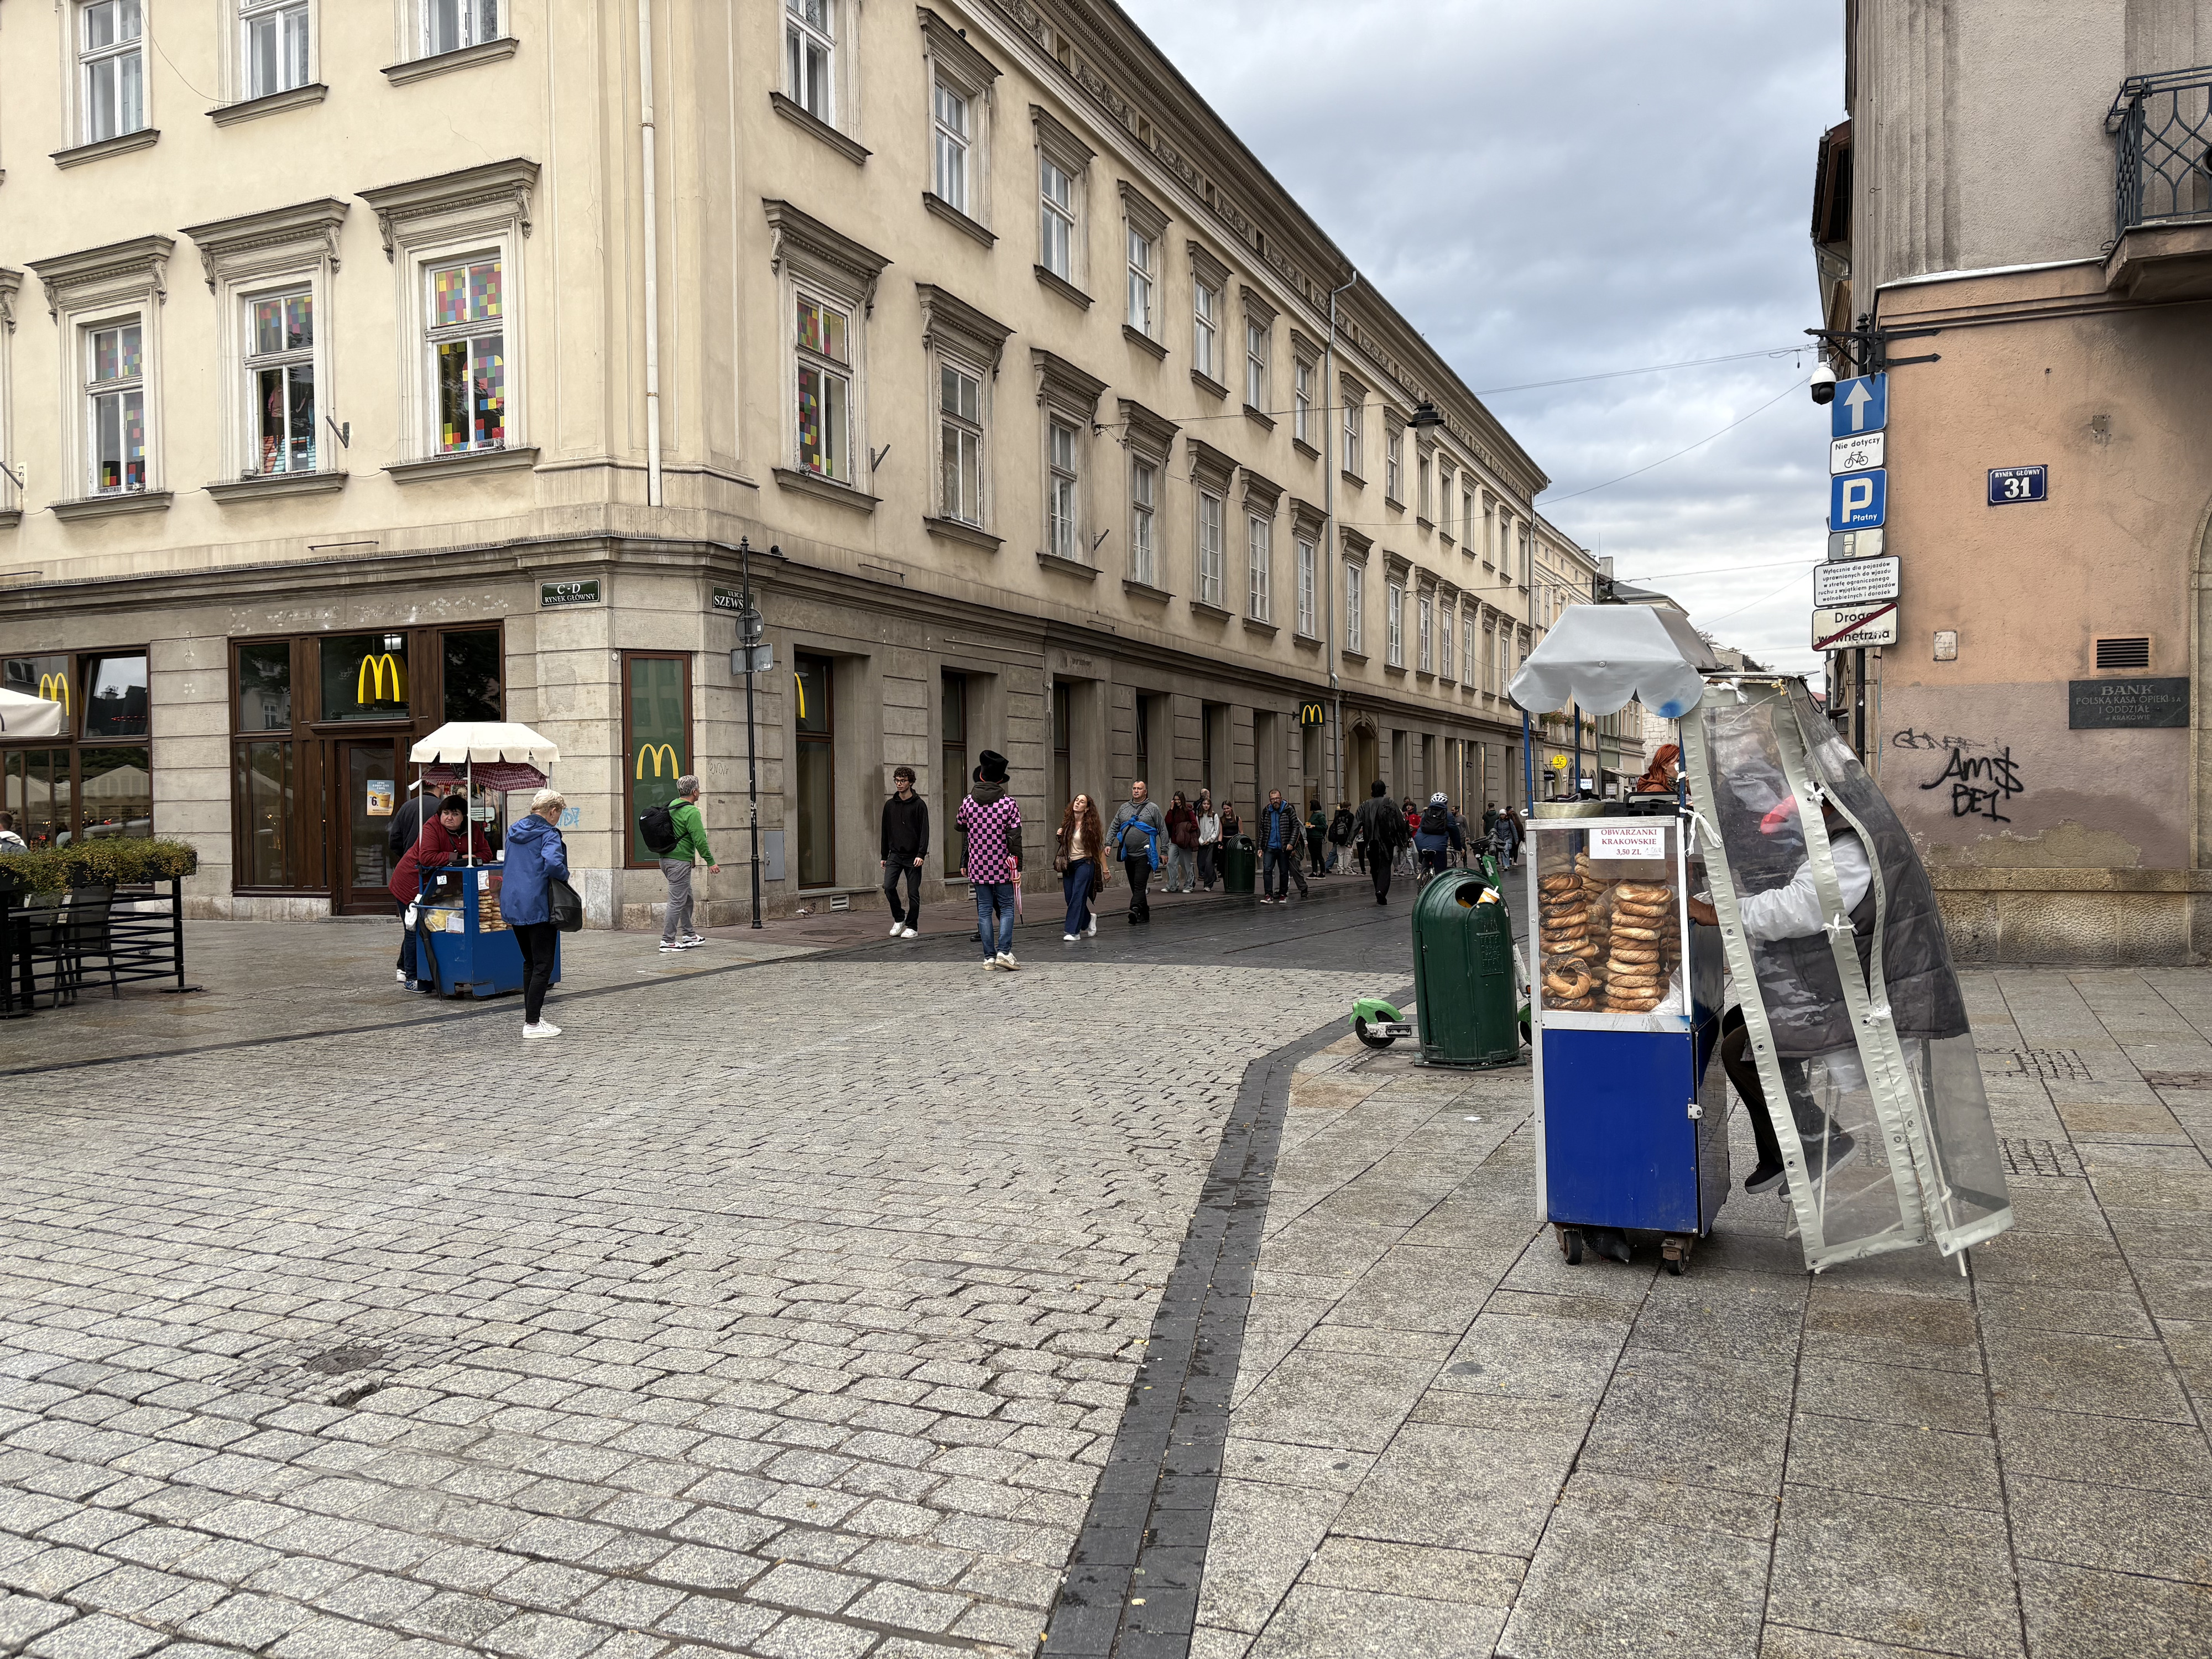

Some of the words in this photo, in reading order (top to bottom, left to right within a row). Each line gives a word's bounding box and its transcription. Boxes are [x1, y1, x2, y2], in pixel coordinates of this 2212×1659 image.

[1851, 437, 1880, 447] dotyczy
[2004, 477, 2031, 498] 31
[1842, 478, 1872, 523] P
[1853, 514, 1877, 522] Płatny
[1823, 566, 1850, 575] Wyłącznie
[1863, 561, 1890, 570] pojazdów
[1823, 572, 1860, 581] uprawnionych
[1846, 577, 1890, 586] ograniczonego
[1869, 582, 1896, 591] pojazdów
[1823, 592, 1863, 601] wolnobieżnych
[714, 595, 754, 609] SZEWSA
[1818, 630, 1890, 643] wwnętrzna
[2101, 685, 2155, 695] BANK
[2077, 696, 2111, 705] POLSKA
[2139, 694, 2168, 703] OPIEKI
[2105, 705, 2150, 713] ODDZIAŁ
